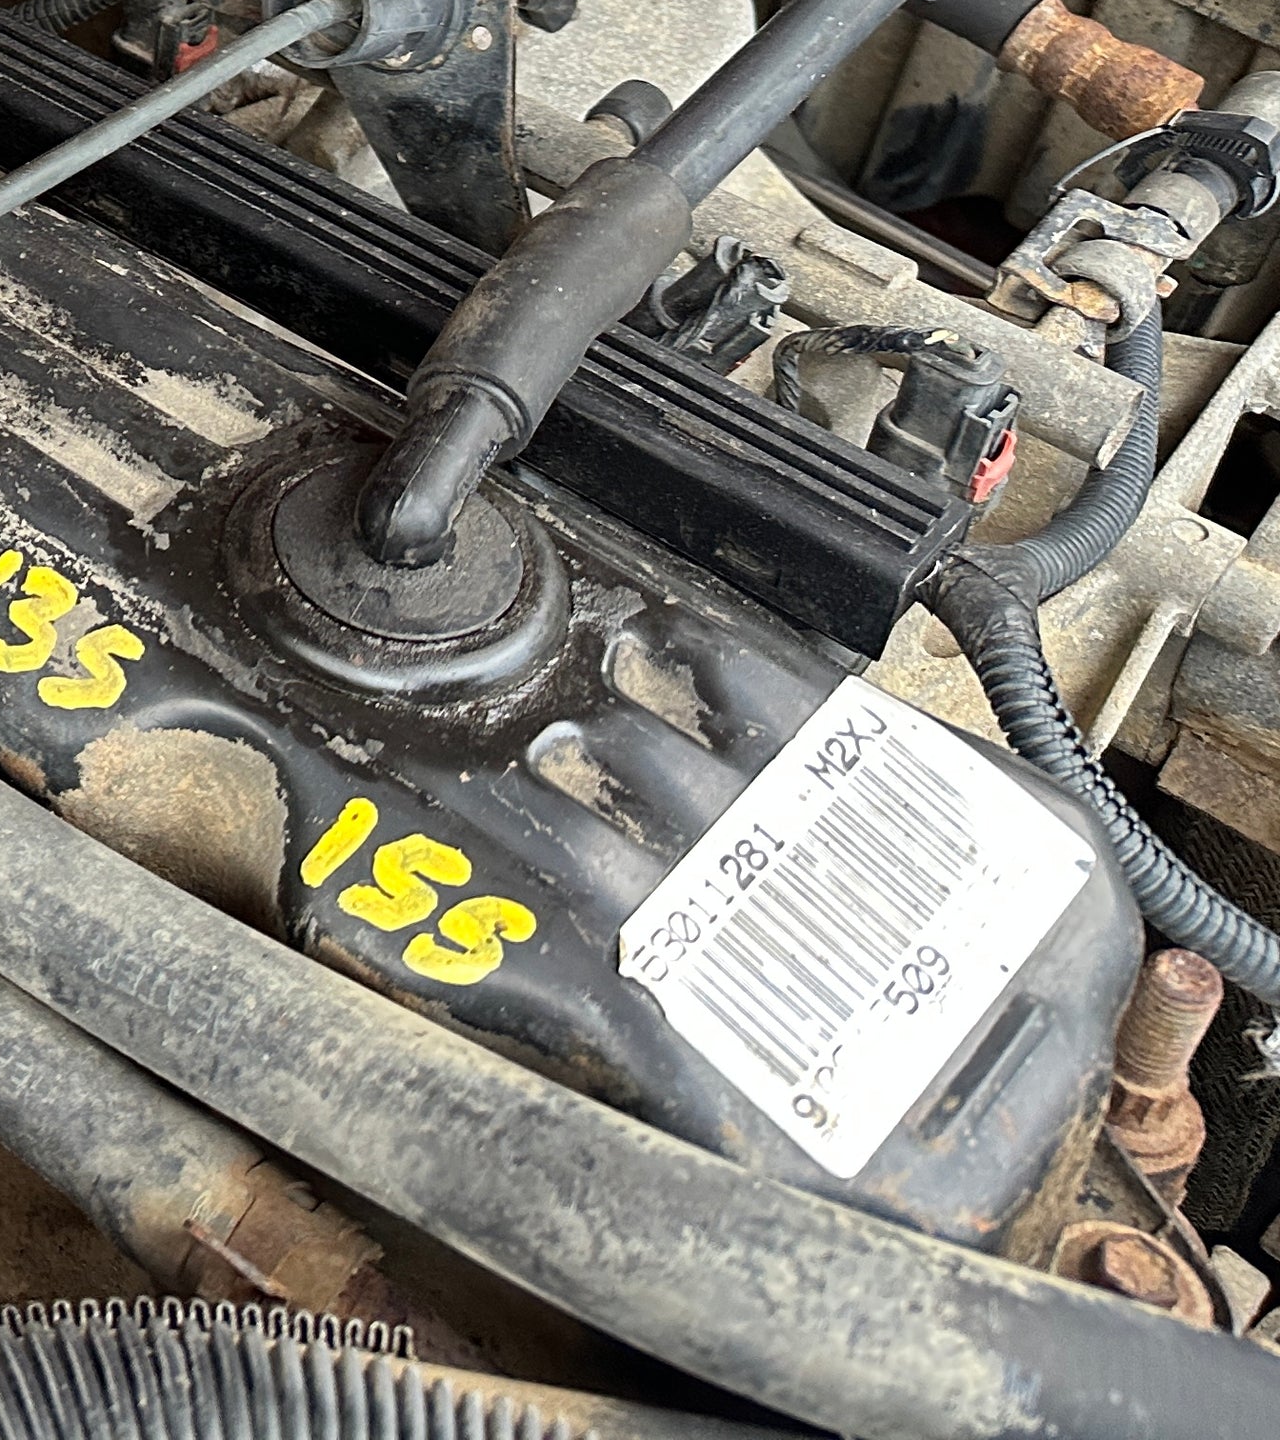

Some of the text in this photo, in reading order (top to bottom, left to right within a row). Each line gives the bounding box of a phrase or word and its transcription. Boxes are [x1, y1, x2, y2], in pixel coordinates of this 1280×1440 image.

[803, 704, 889, 791] M2XJ
[300, 797, 537, 986] 155
[632, 823, 786, 982] 53011281
